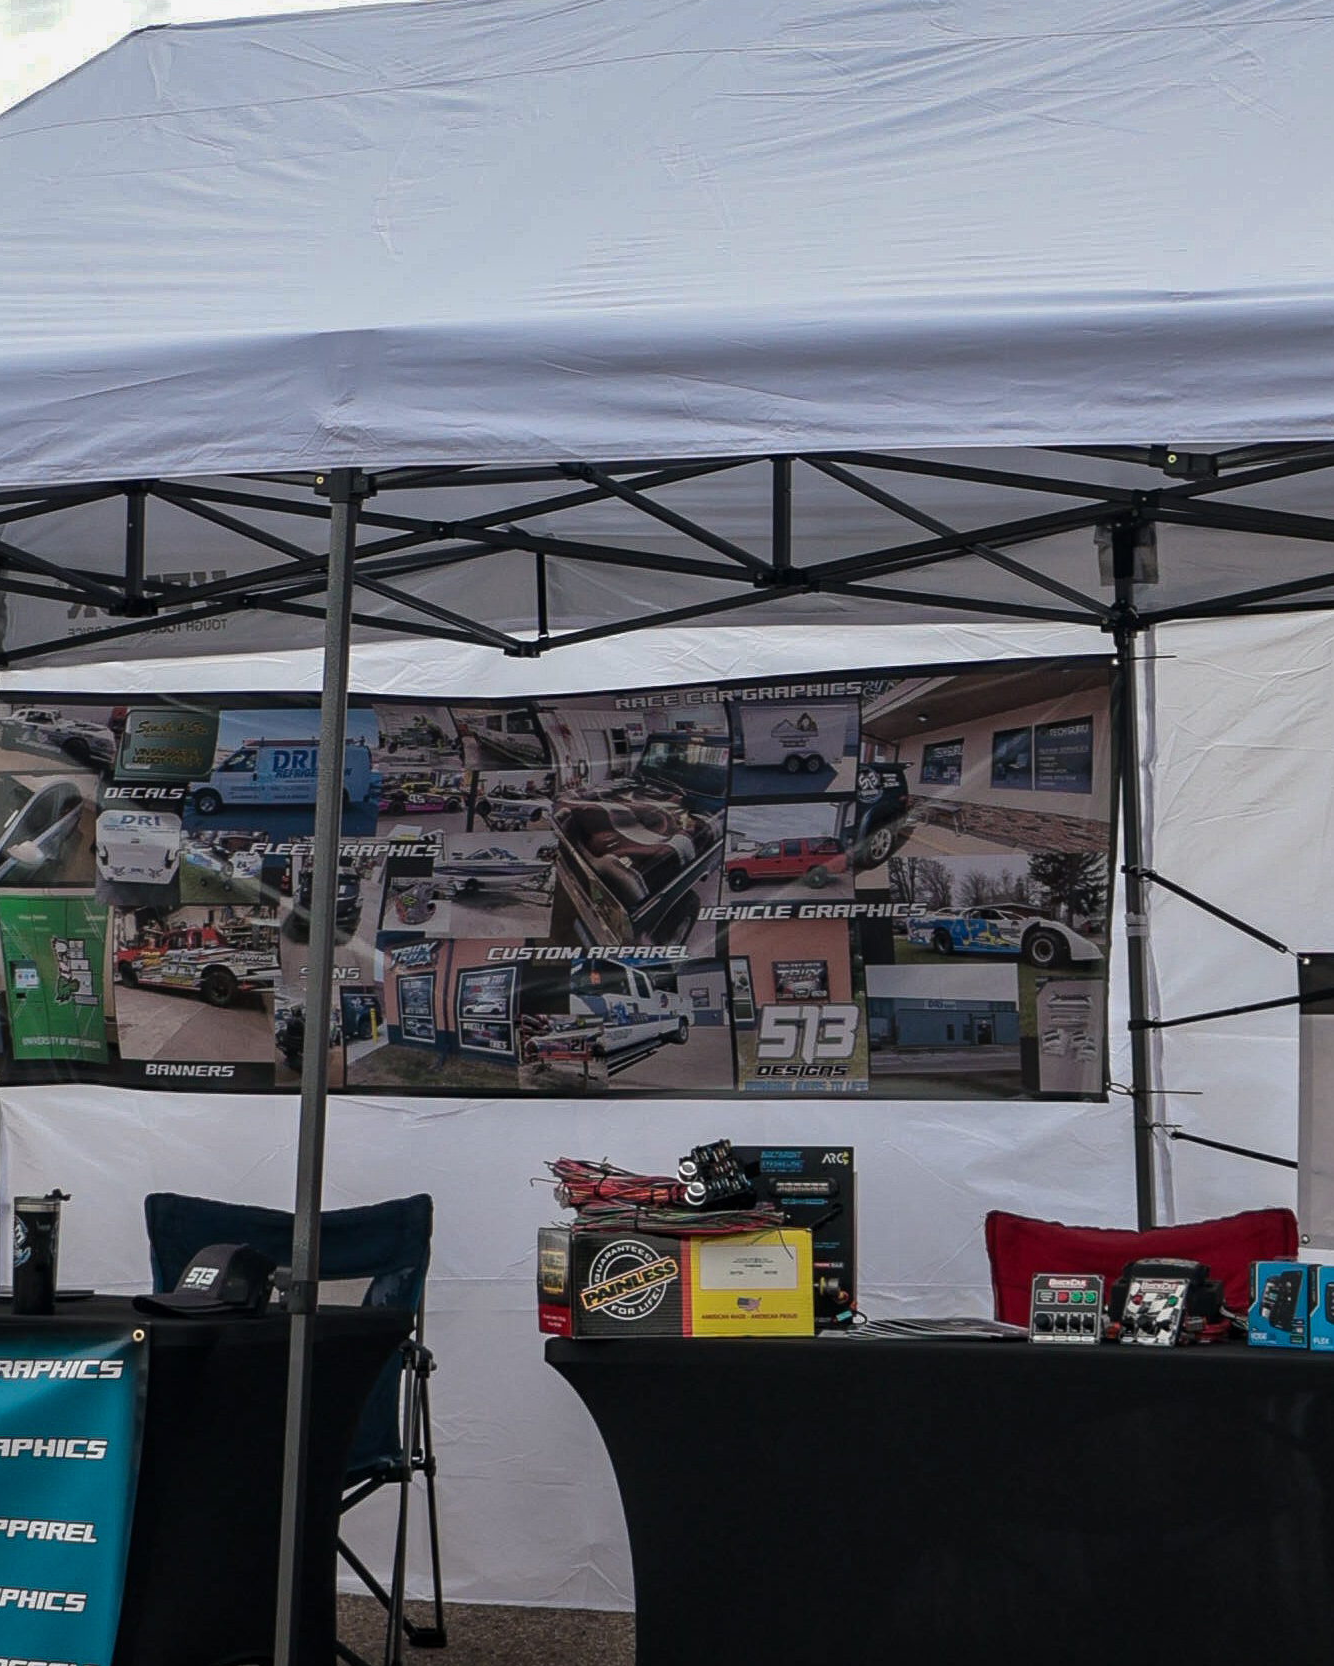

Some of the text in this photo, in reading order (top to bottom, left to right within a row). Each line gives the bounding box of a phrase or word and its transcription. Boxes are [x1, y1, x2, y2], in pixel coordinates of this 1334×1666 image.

[615, 682, 862, 710] RACE CAR GRAPHICS
[101, 787, 184, 802] DECALS
[696, 902, 928, 923] VEHICLE GRAPHICS
[486, 945, 690, 961] CUSTOM APPAREL
[757, 1004, 859, 1064] 513
[146, 1064, 235, 1077] BANNERS
[756, 1065, 849, 1078] DESIGNS
[594, 1245, 653, 1282] GUARANTEED
[185, 1267, 219, 1285] 513
[580, 1258, 679, 1310] PAINLESS
[611, 1287, 662, 1315] FOR LIFE!
